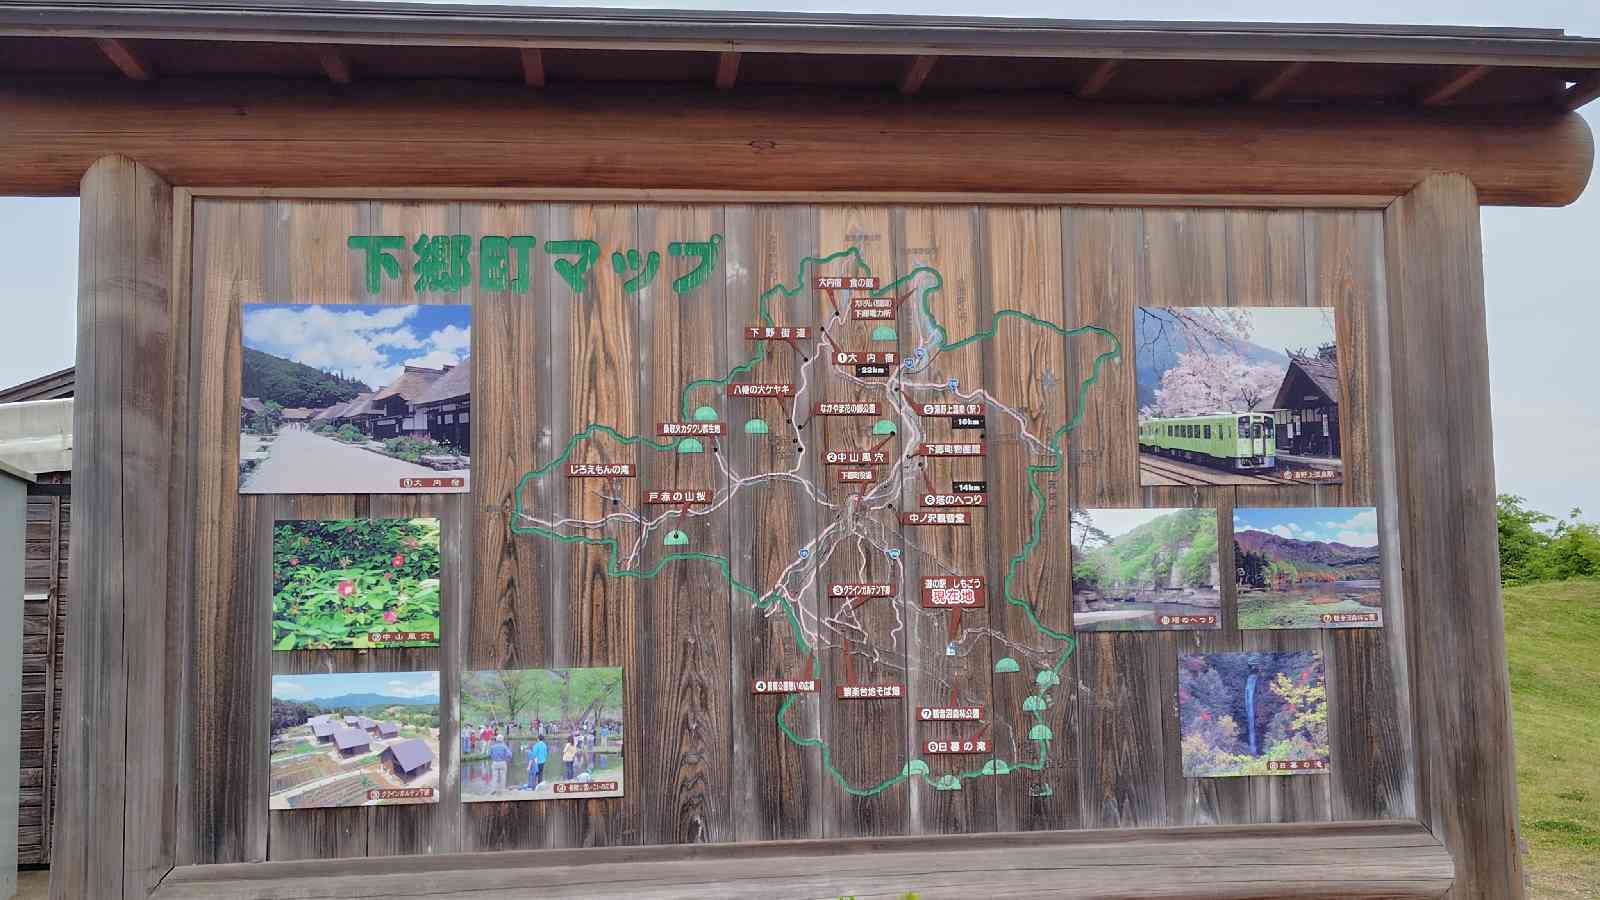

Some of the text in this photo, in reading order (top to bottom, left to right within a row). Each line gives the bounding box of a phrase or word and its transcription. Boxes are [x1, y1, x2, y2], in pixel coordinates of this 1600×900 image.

[347, 233, 722, 295] 下郷町マップ
[751, 328, 806, 337] 下野街道
[570, 464, 630, 474] じろえもんの滝
[649, 491, 706, 501] 戸赤の山桜
[932, 589, 975, 604] 現在地
